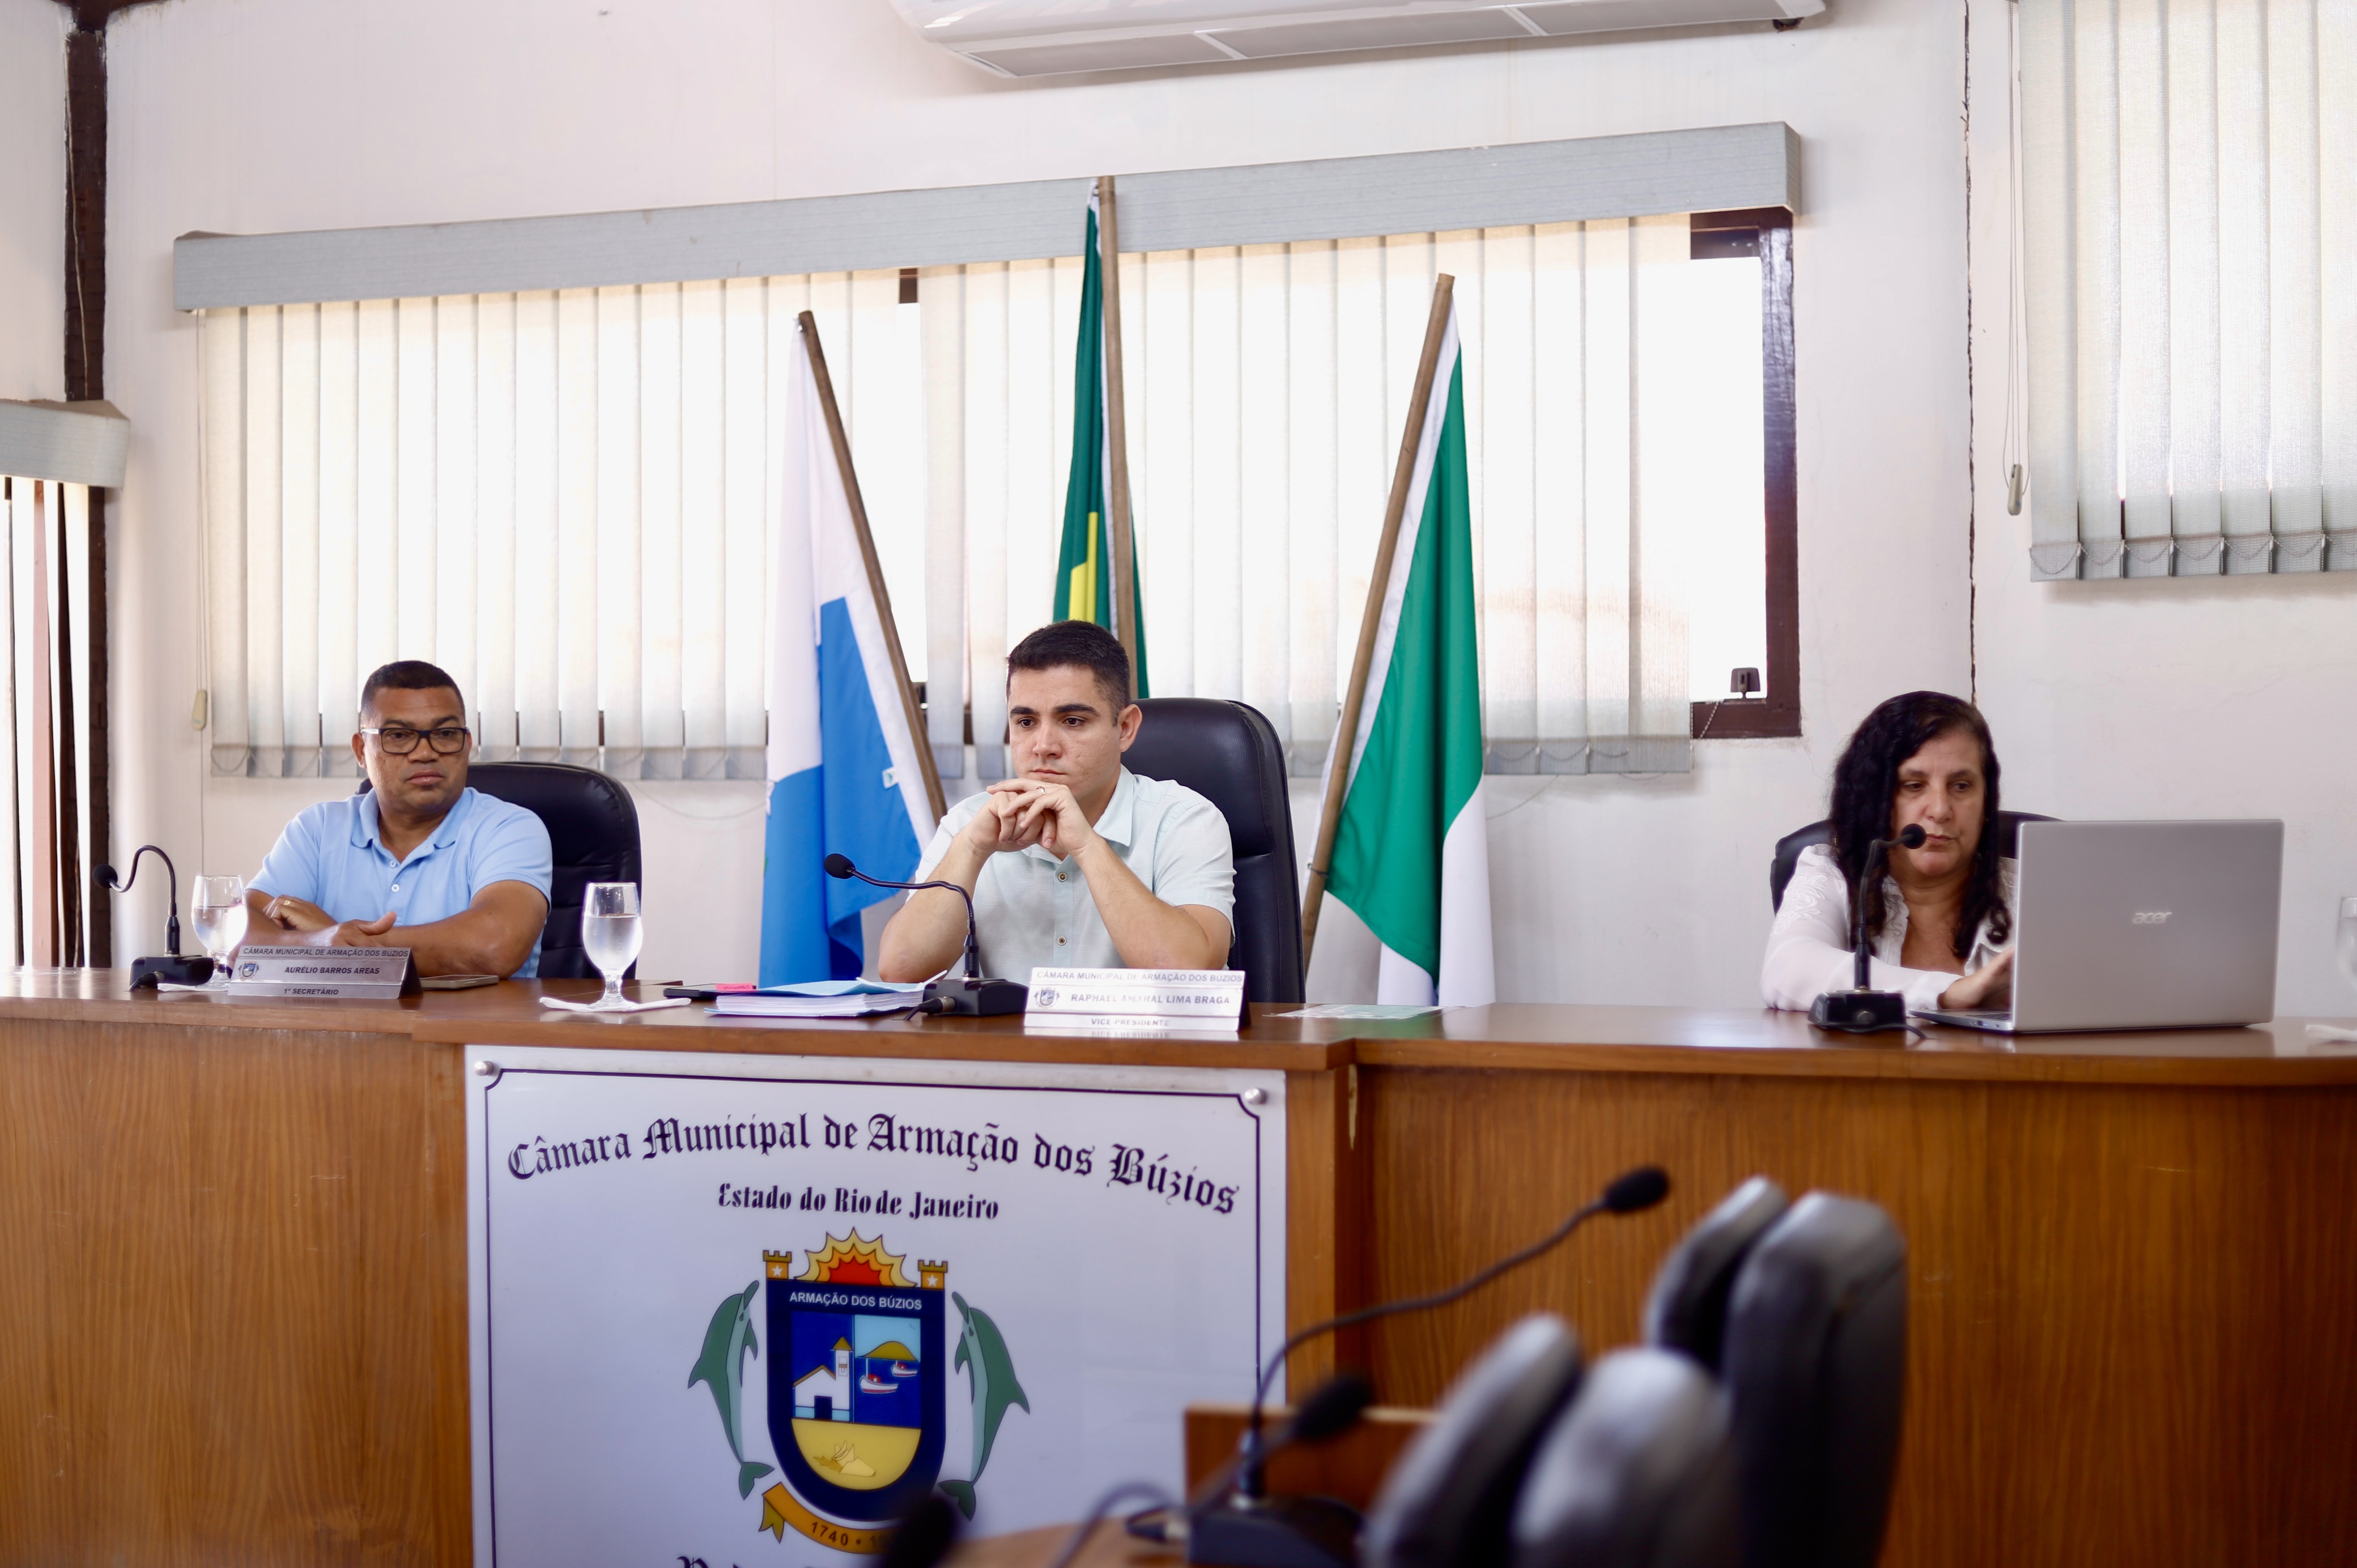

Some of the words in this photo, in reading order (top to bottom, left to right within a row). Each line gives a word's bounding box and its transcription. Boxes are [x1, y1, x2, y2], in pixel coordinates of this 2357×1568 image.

[2131, 911, 2172, 924] acer
[1037, 970, 1075, 979] CÂMARA
[1141, 972, 1186, 983] ARMAÇÃO
[1210, 973, 1243, 982] BÚZIOS
[1071, 994, 1117, 1002] RAPHAEL
[1121, 994, 1163, 1003] AMARAL
[1194, 996, 1229, 1004] BRAGA
[508, 1132, 632, 1180] Câmara
[642, 1113, 811, 1161] Municipal
[823, 1114, 858, 1150] de
[866, 1113, 1018, 1171] Armação
[1033, 1132, 1095, 1175] dos
[1107, 1143, 1240, 1214] Búzios
[718, 1183, 792, 1211] Estado
[800, 1186, 826, 1212] do
[834, 1187, 871, 1214] Rio
[875, 1190, 901, 1215] de
[909, 1191, 999, 1220] Janeiro
[789, 1292, 848, 1306] ARMAÇÃO
[852, 1296, 875, 1307] DOS
[879, 1295, 922, 1310] BÚZIOS
[812, 1522, 848, 1546] 1740
